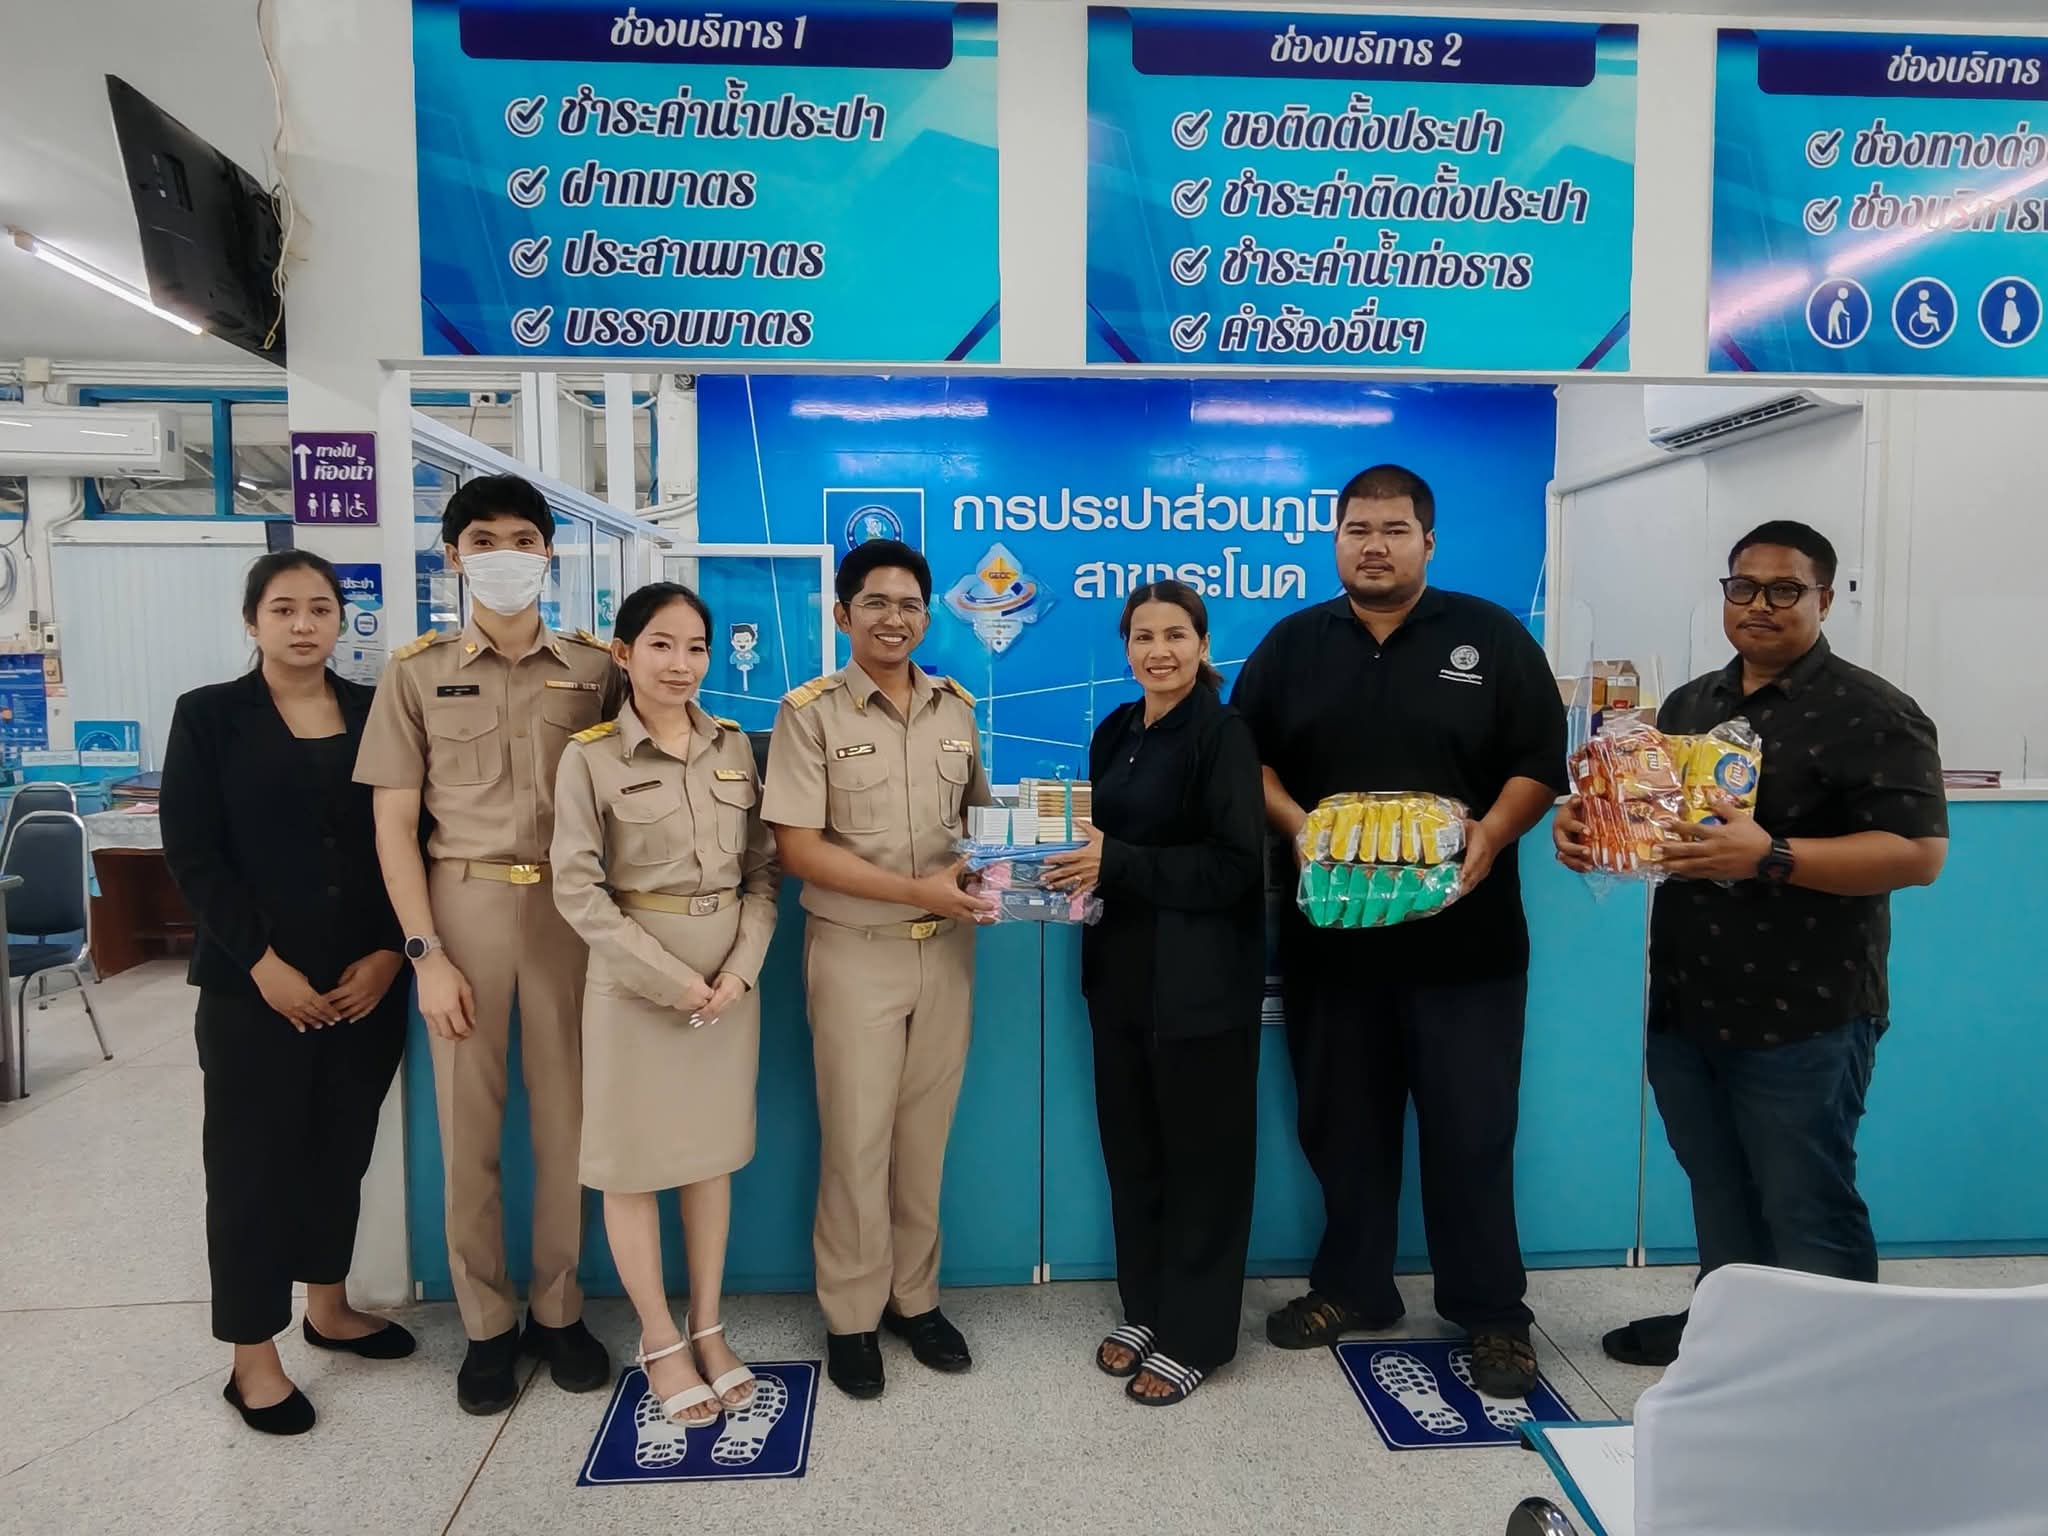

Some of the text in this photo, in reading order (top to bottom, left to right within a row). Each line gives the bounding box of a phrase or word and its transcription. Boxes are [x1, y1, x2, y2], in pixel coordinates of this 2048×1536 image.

[610, 7, 807, 50] ช่องบริการ 1
[1270, 24, 1463, 68] ช่องบริการ 2
[1887, 45, 2041, 85] ช่องบริการ
[558, 77, 886, 141] ชำระค่าน้ำประปา
[1221, 92, 1505, 155] ขอติดตั้งประปา
[1851, 117, 2048, 169] ช่องทางด่ว
[560, 160, 756, 208] ฝากมาตร
[1220, 163, 1590, 225] ชำระค่าติดตั้งประปา
[1850, 182, 2048, 234] ช่องบริการ
[562, 229, 825, 279] ประสานมาตร
[1220, 229, 1533, 290] ชำระค่าน้ำท่อธาร
[565, 307, 814, 347] บรรจบมาตร
[1218, 297, 1427, 356] คำร้องอื่นๆ
[314, 456, 374, 480] ห้องน้ำ
[316, 441, 357, 458] ทางไป
